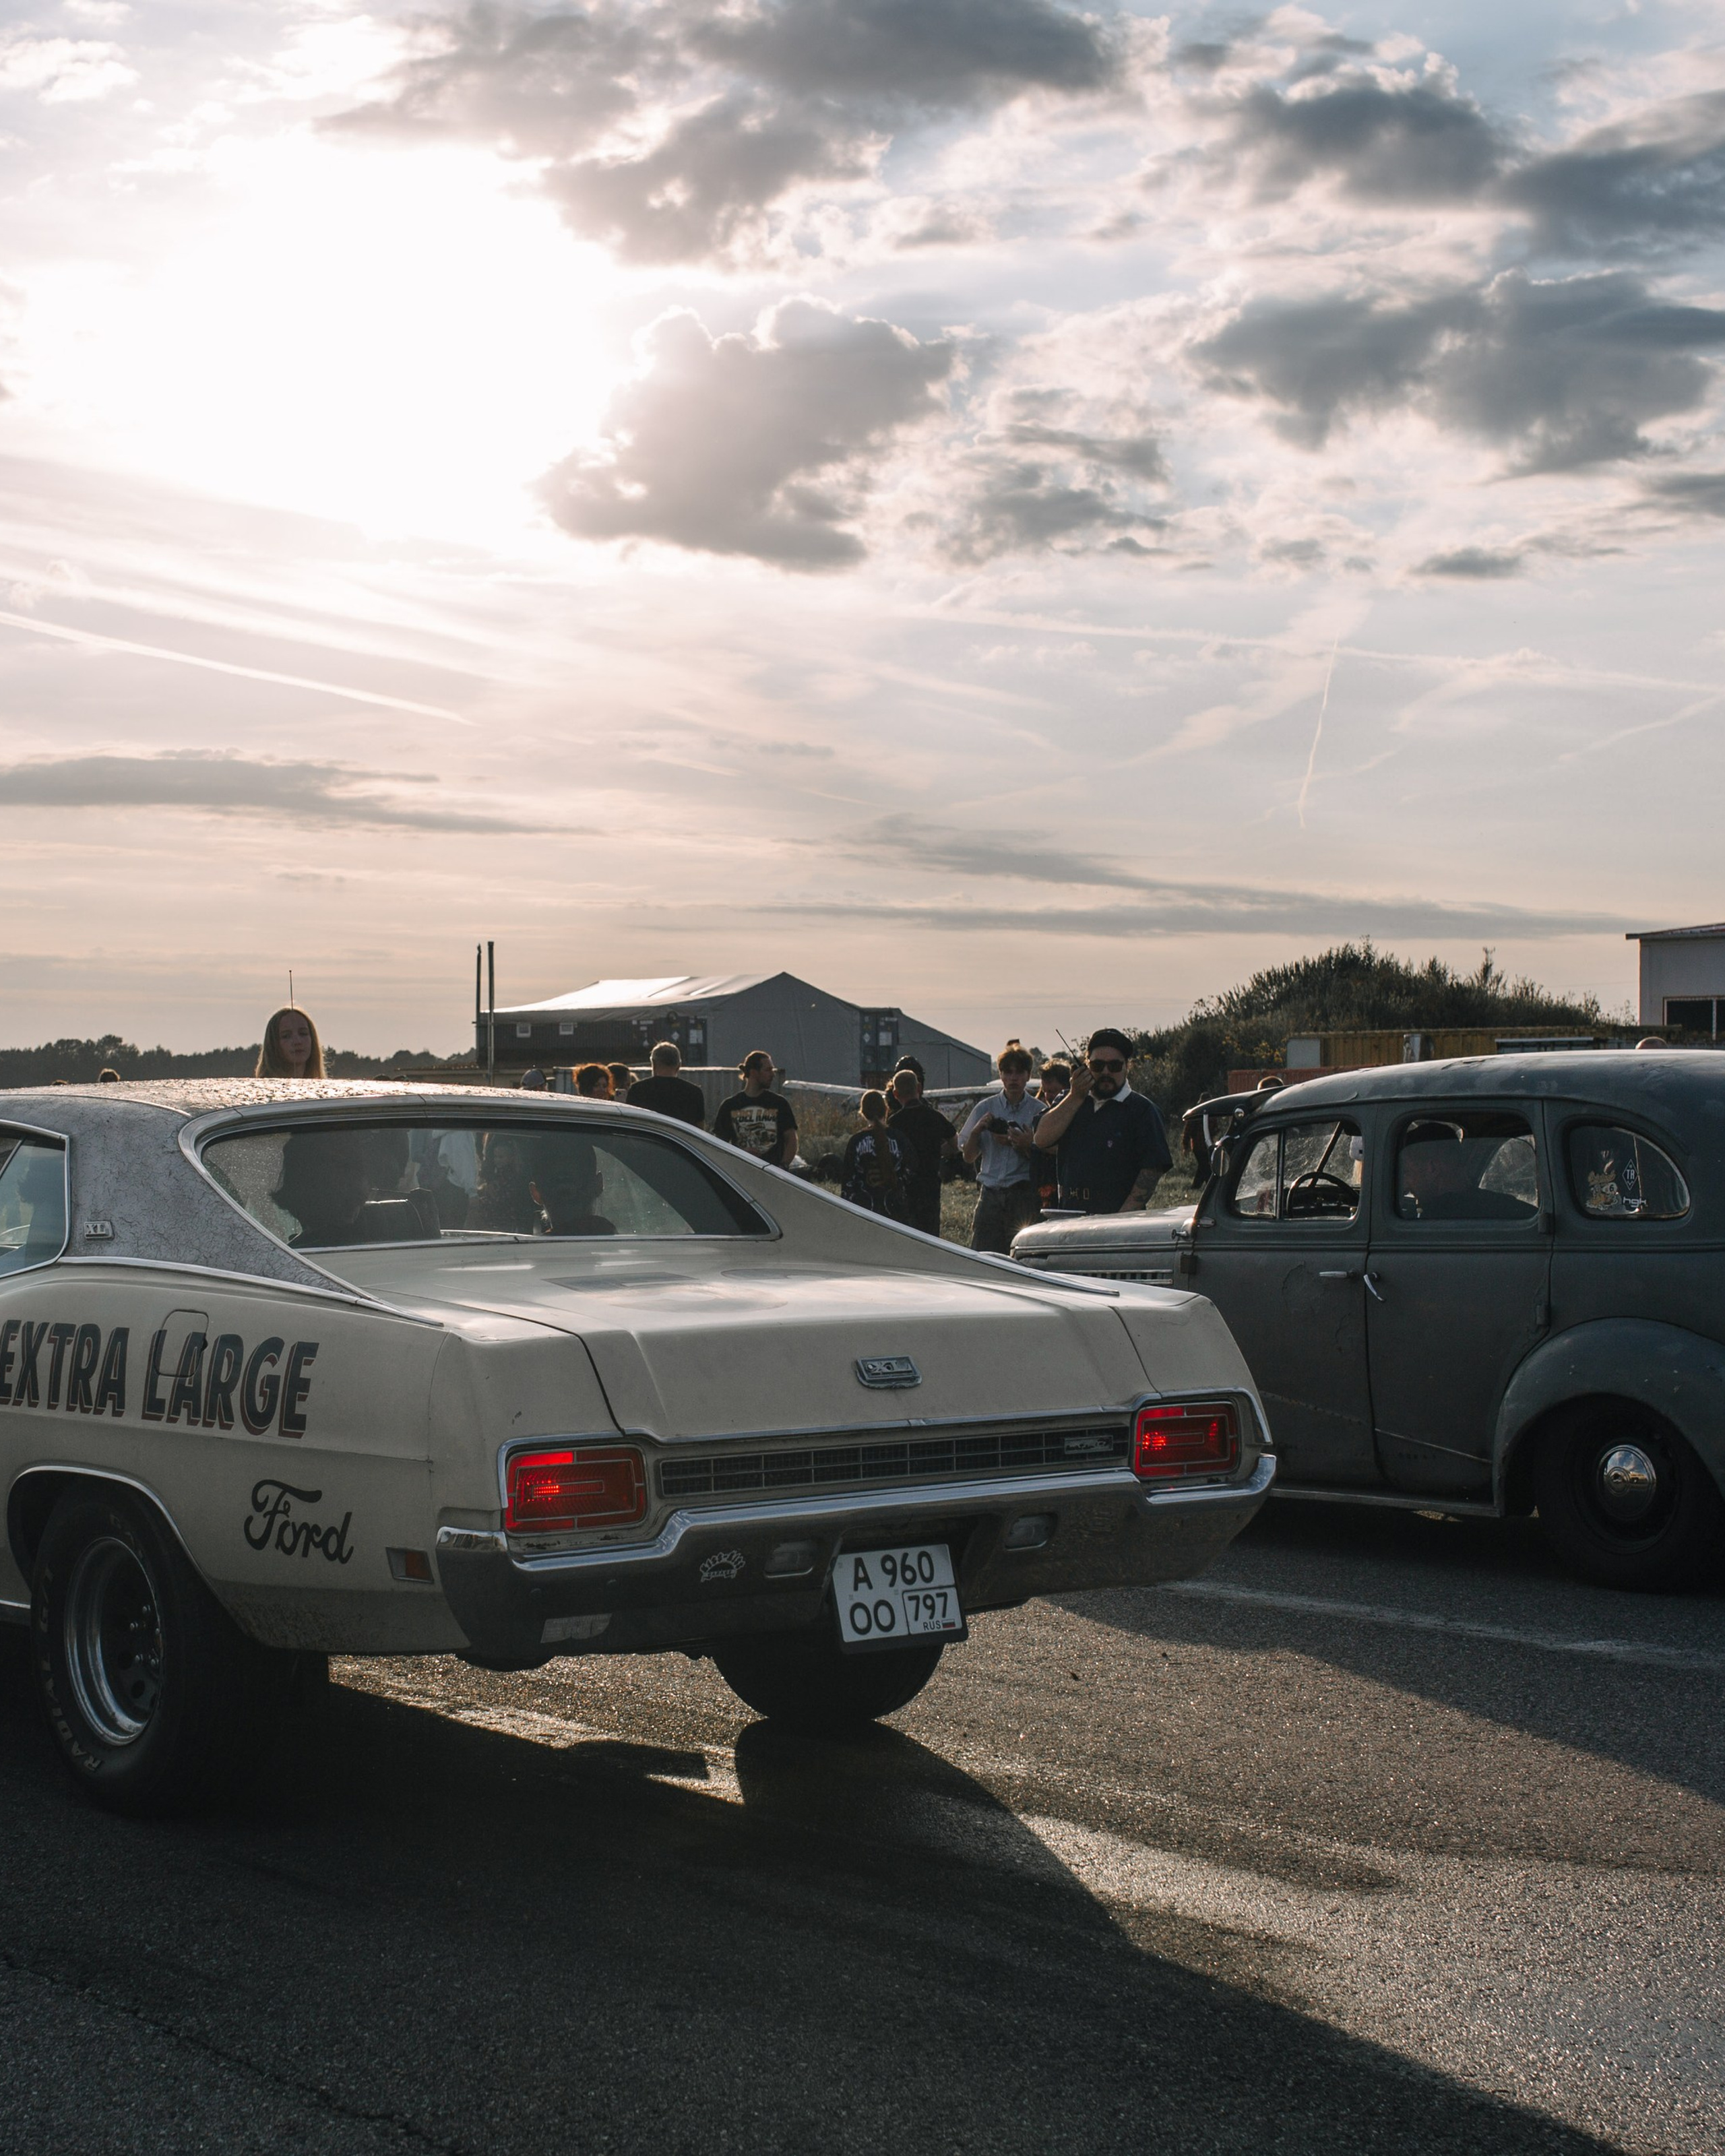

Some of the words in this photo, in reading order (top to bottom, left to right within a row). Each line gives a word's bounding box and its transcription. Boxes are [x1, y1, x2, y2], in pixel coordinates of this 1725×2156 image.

[1623, 1197, 1646, 1207] hgk
[0, 1320, 129, 1417] EXTRA
[141, 1329, 319, 1439] LARGE
[244, 1480, 354, 1564] Ford
[853, 1557, 873, 1591] A
[881, 1551, 935, 1587] 960
[908, 1592, 947, 1621] 797
[923, 1620, 941, 1631] RUS
